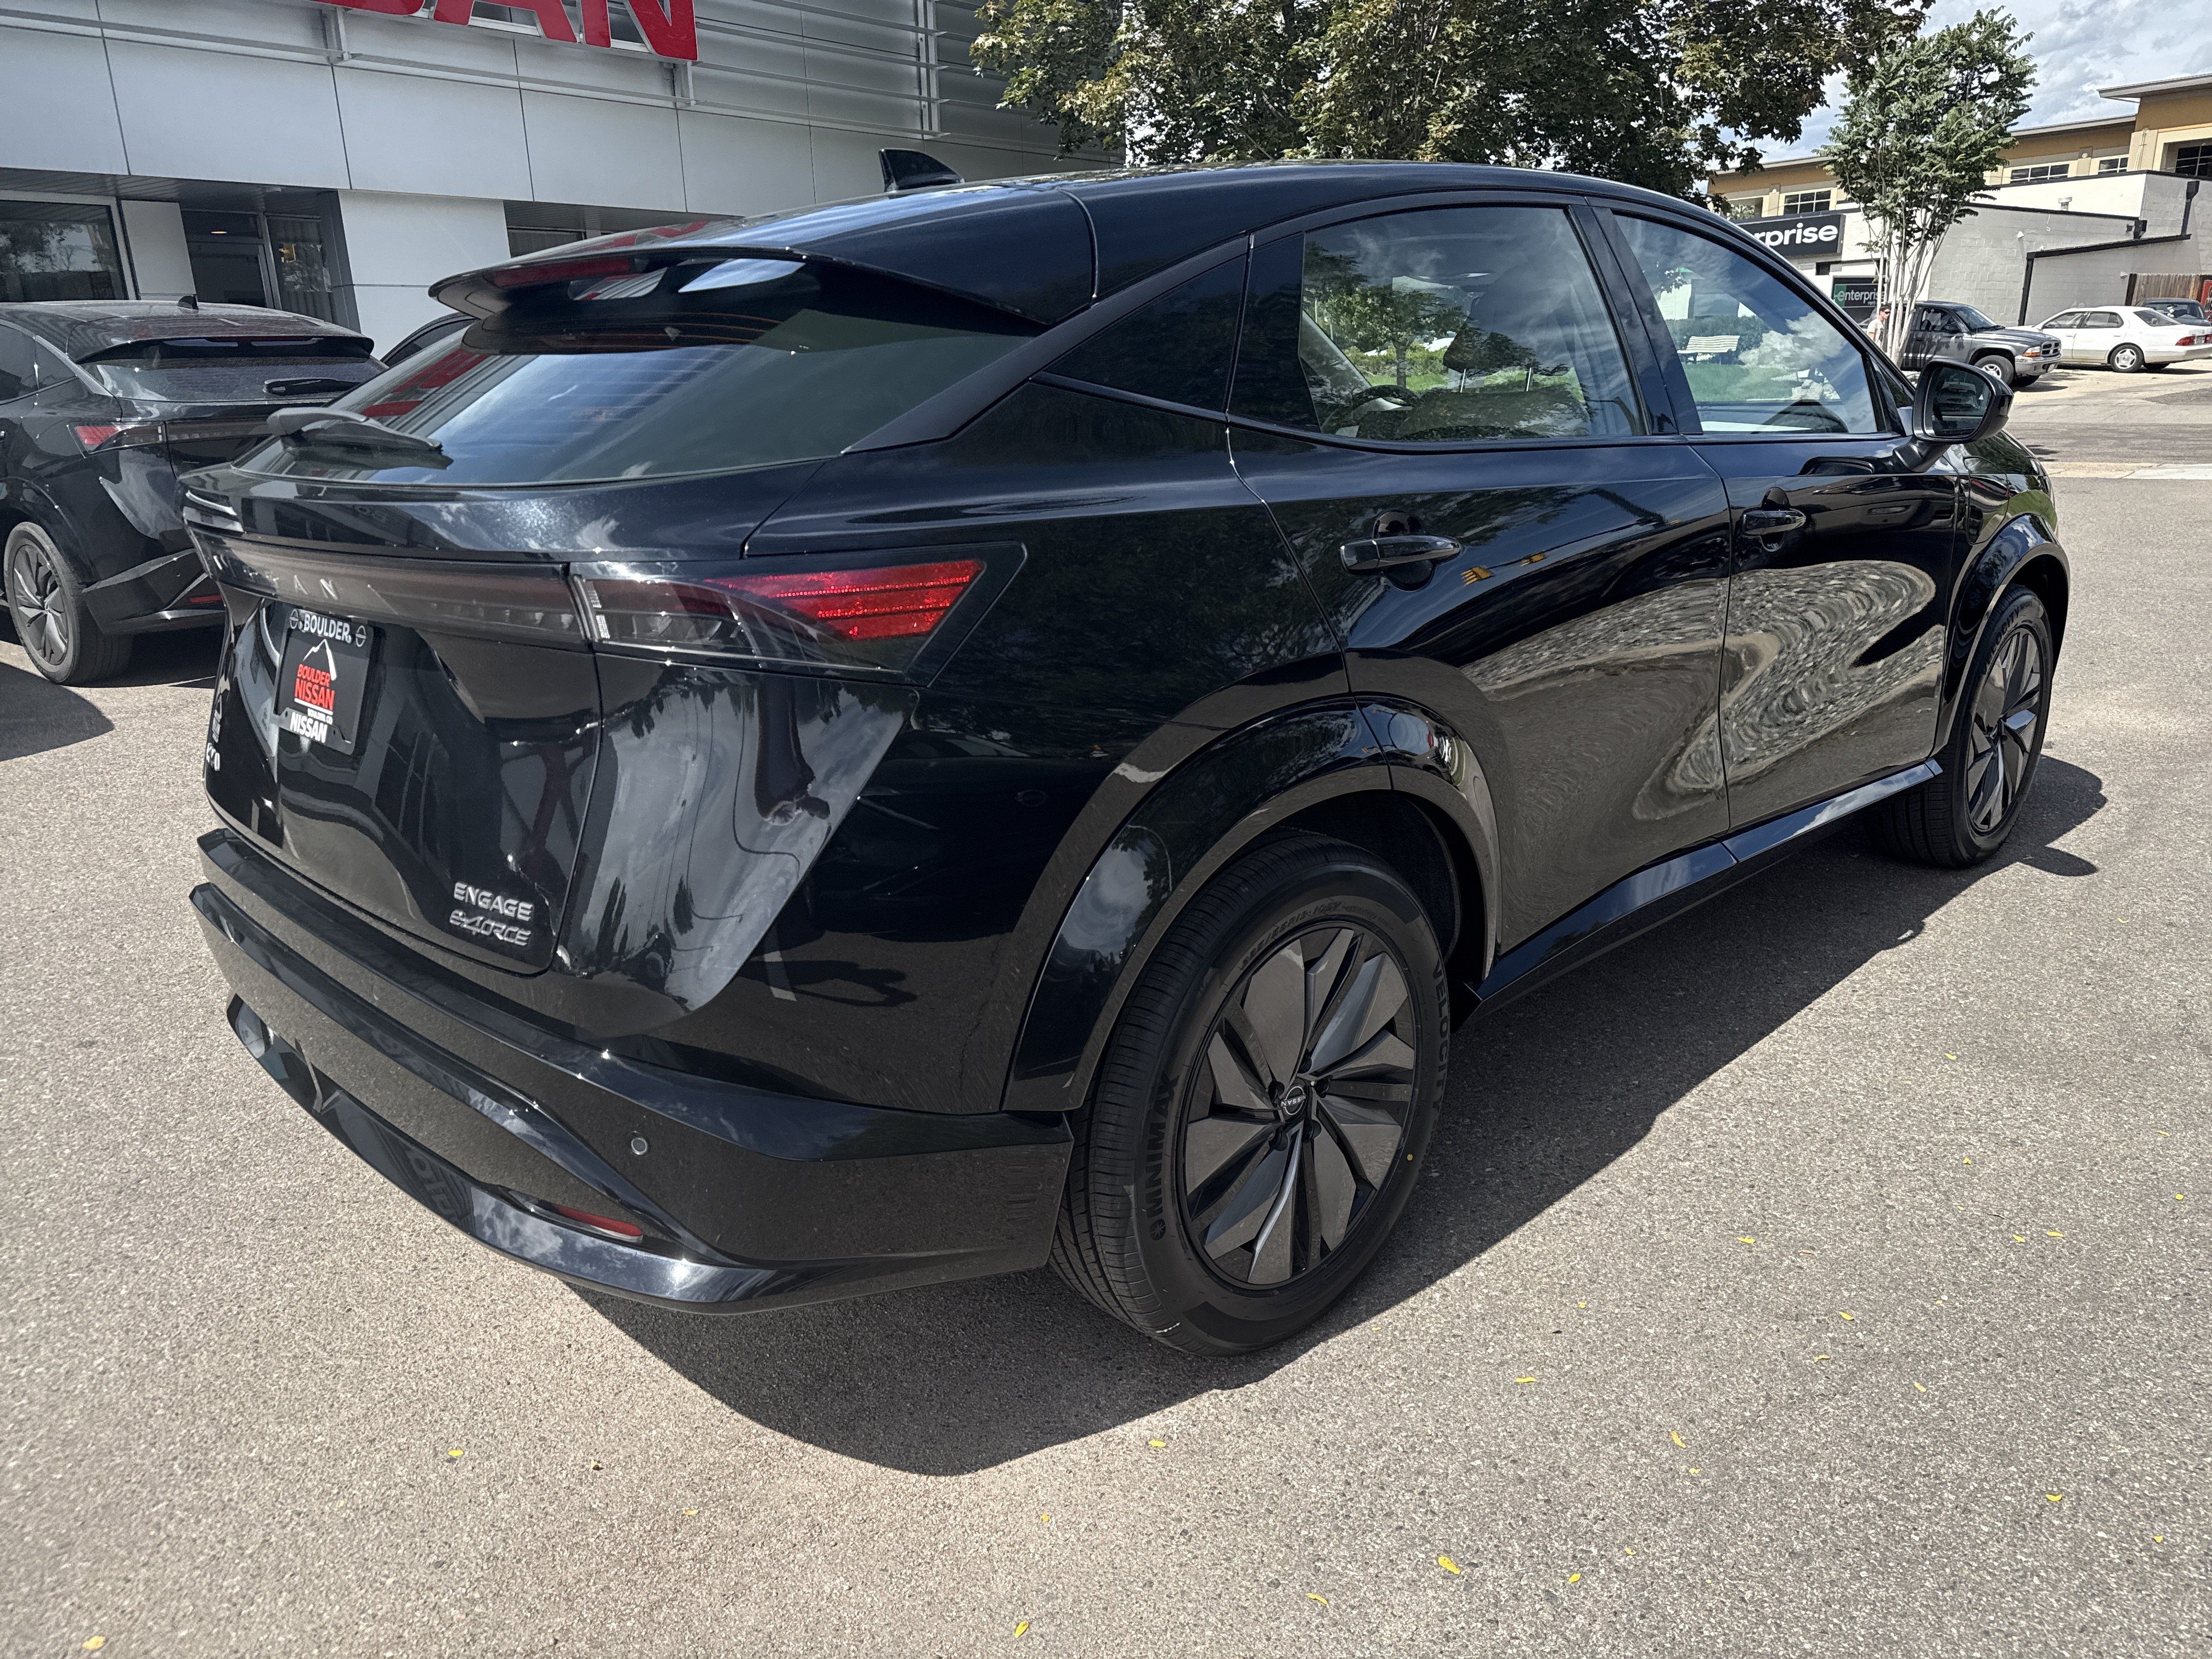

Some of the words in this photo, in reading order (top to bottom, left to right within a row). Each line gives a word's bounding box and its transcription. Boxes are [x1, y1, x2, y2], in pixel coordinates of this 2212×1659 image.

[1754, 222, 1838, 247] rprise
[304, 613, 351, 642] BOULDER
[297, 663, 330, 687] BOULDER
[295, 678, 335, 711] NISSAN
[290, 712, 328, 743] NISSAN
[454, 882, 534, 922] ENGAGE
[1432, 958, 1449, 1113] VELOCITY
[1281, 1094, 1306, 1107] NISSAN
